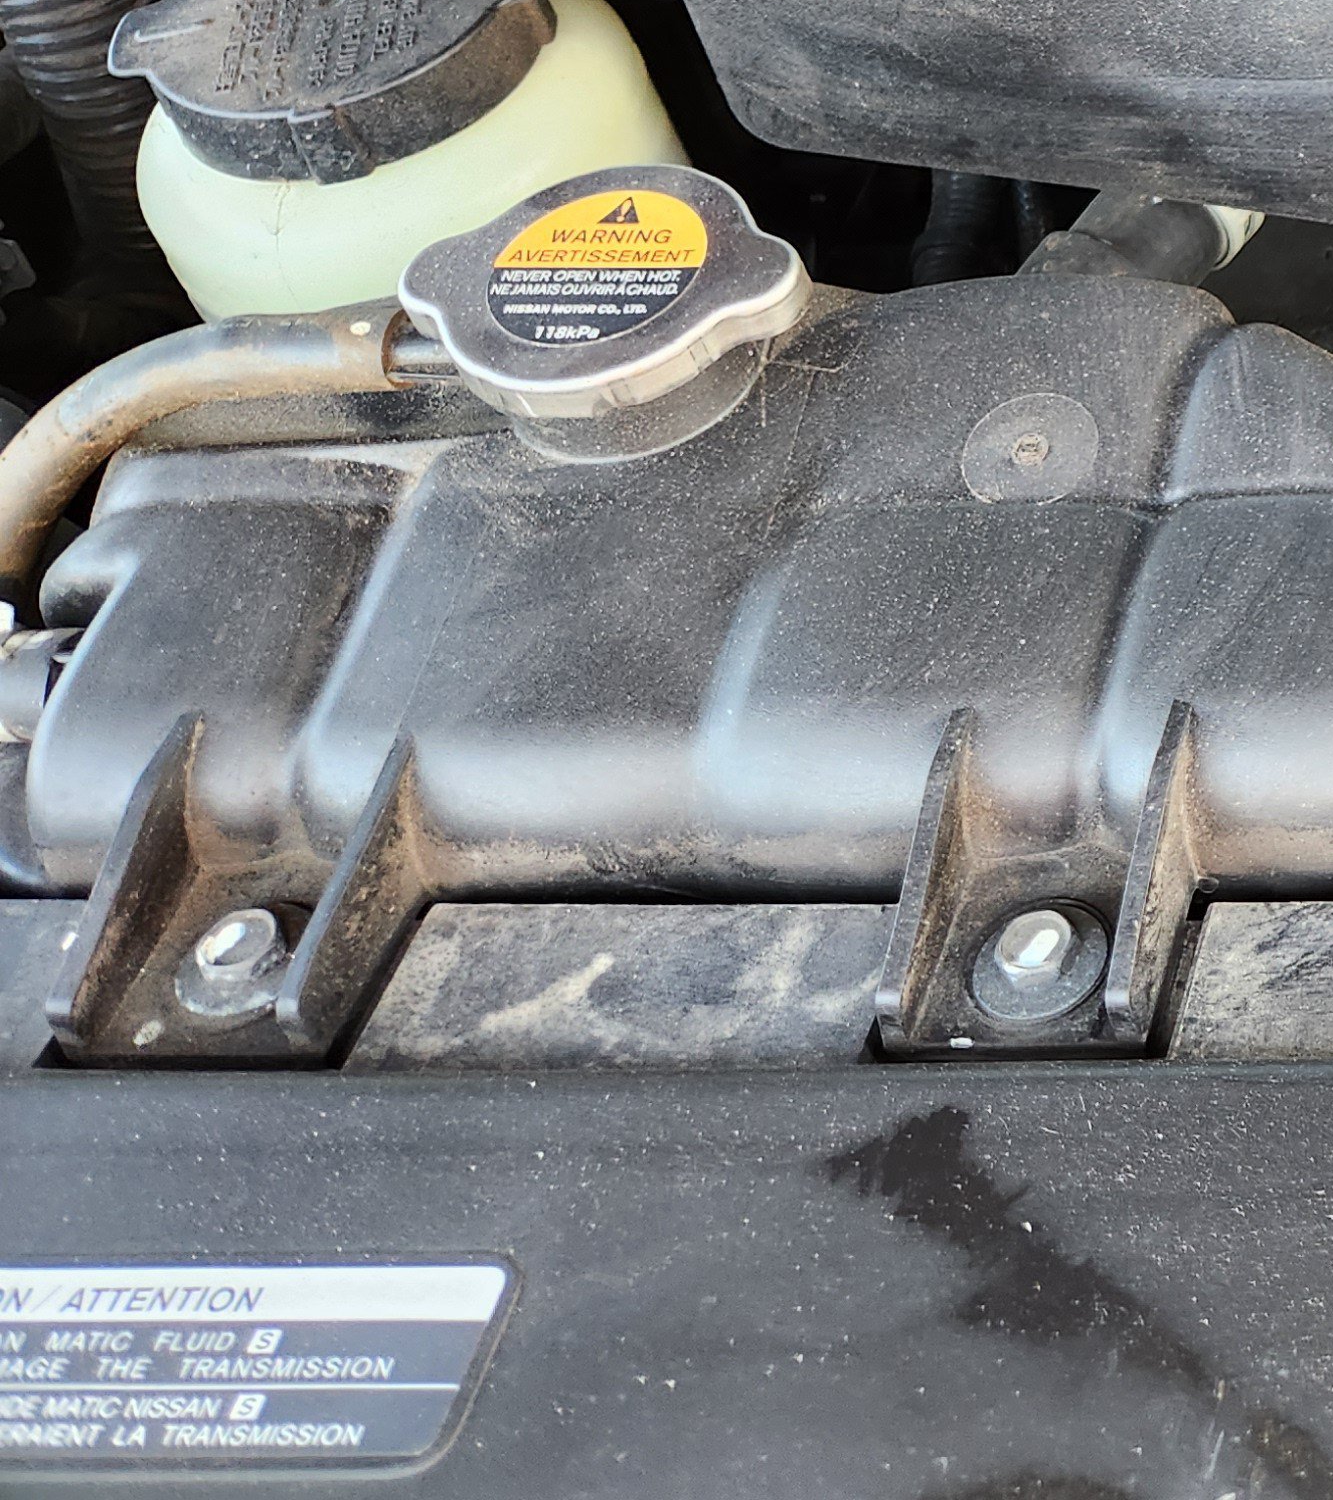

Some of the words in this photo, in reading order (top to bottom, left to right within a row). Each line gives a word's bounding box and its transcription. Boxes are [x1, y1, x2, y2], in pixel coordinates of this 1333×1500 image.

[551, 228, 673, 244] WARNING
[508, 249, 696, 263] AVERTISSEMENT
[501, 270, 552, 282] NEVER
[553, 270, 597, 282] OPEN
[598, 270, 647, 282] WHEN
[647, 270, 681, 282] HOT.
[490, 283, 512, 295] NE
[510, 283, 561, 296] JAMAIS
[561, 283, 616, 295] OUVRIR
[503, 303, 551, 314] NISSAN
[551, 303, 597, 315] MOTOR
[534, 325, 600, 340] 118kPa
[0, 1287, 34, 1313] N
[59, 1286, 264, 1313] ATTENTION
[44, 1330, 134, 1353] MATIC
[152, 1330, 237, 1353] FLUID
[96, 1356, 152, 1380] THE
[178, 1356, 395, 1380] TRANSMISSION
[42, 1395, 122, 1419] MATIC
[123, 1395, 223, 1420] NISSAN
[111, 1423, 147, 1447] LA
[161, 1422, 366, 1448] TRANSMISSION
